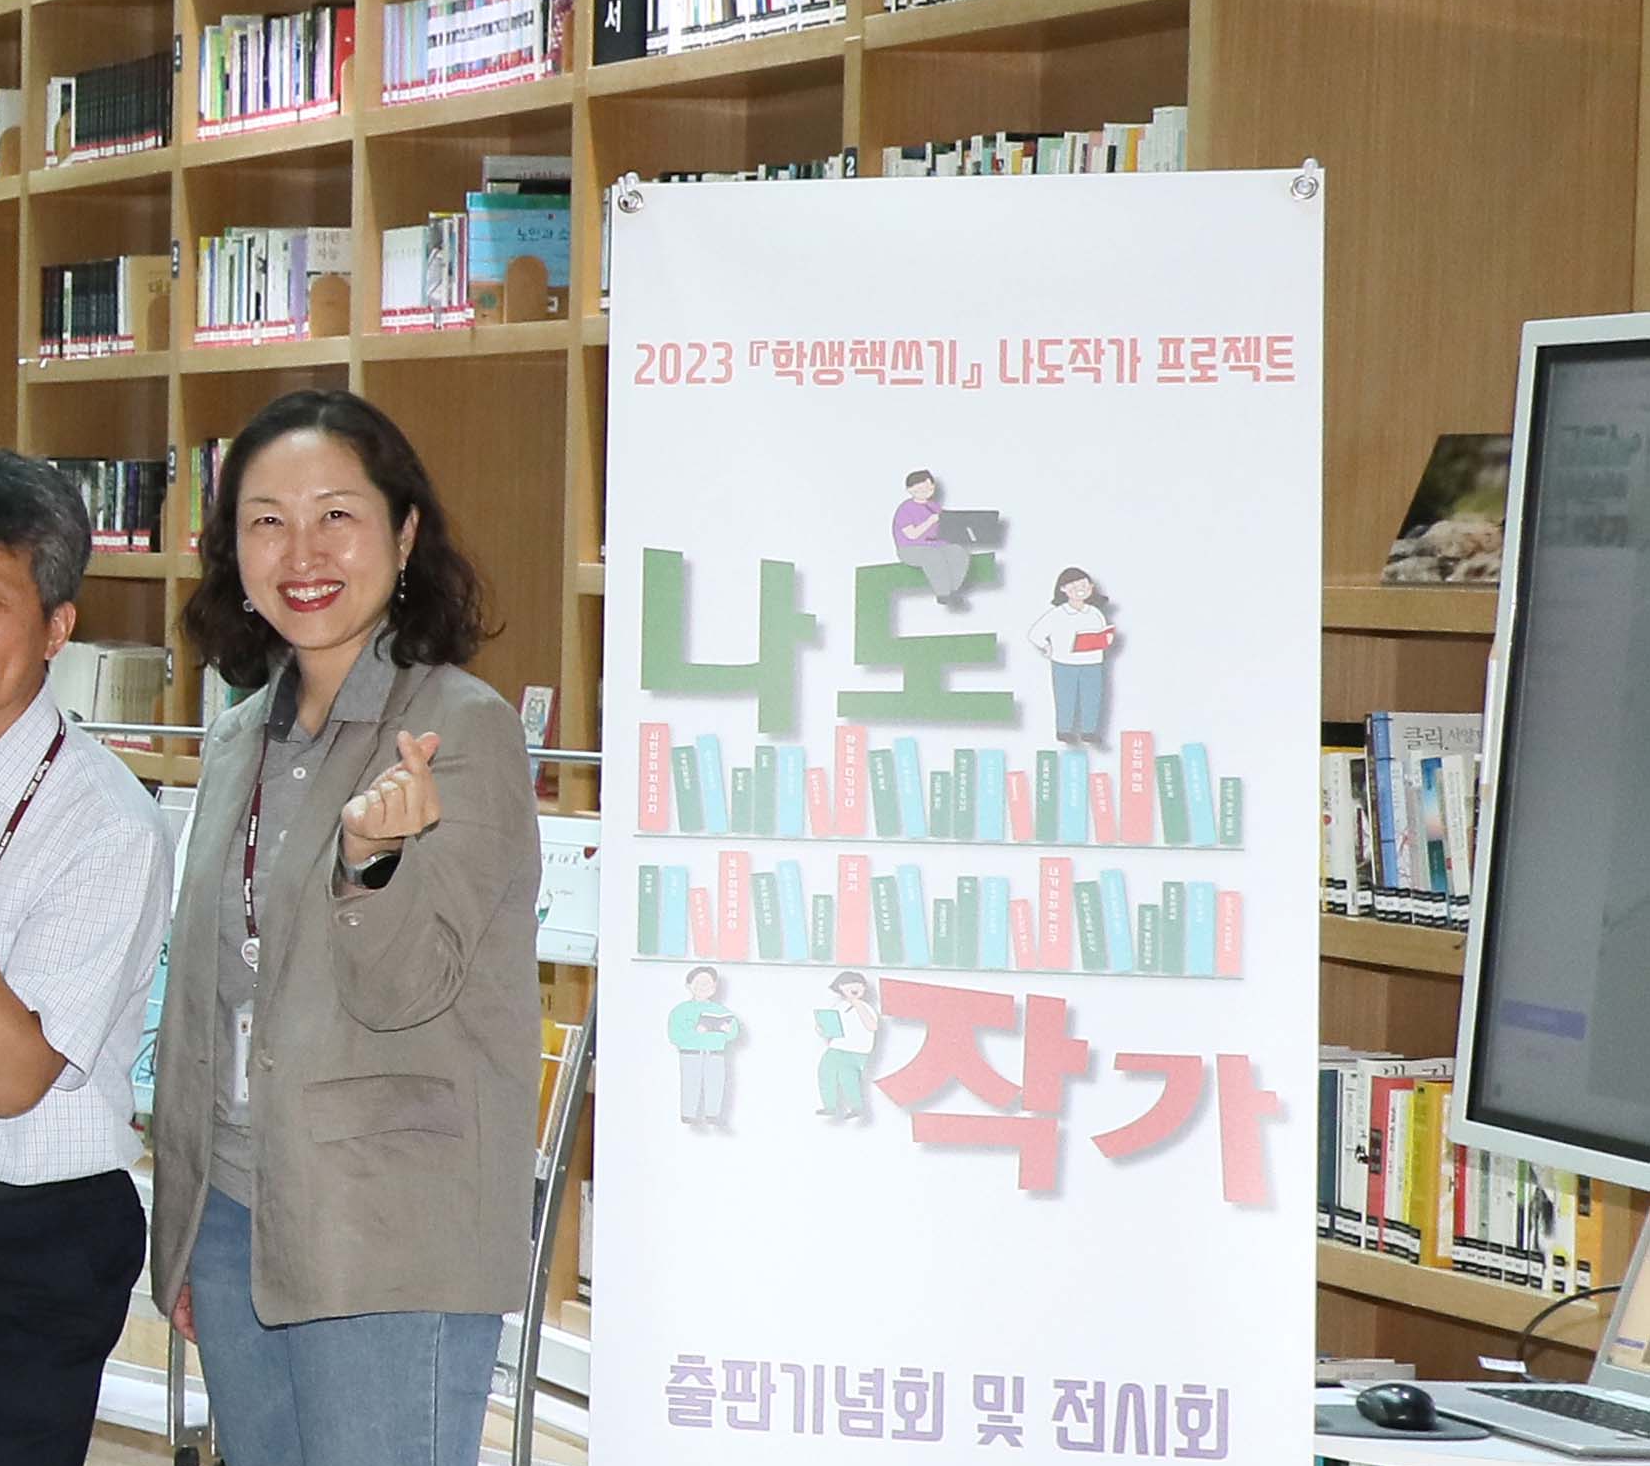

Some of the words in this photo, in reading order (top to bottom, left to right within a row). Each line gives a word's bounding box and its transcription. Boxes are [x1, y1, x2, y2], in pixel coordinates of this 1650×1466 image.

[845, 155, 856, 177] 2
[634, 342, 734, 386] 2023
[748, 338, 983, 389] 『학생책쓰기』
[999, 336, 1141, 386] 나도작가
[1157, 334, 1297, 385] 프로젝트
[640, 546, 1015, 734] 나도
[873, 977, 1278, 1203] 작가
[664, 1354, 945, 1443] 출판기념회
[972, 1374, 1026, 1448] 및
[1051, 1378, 1231, 1461] 전시회
